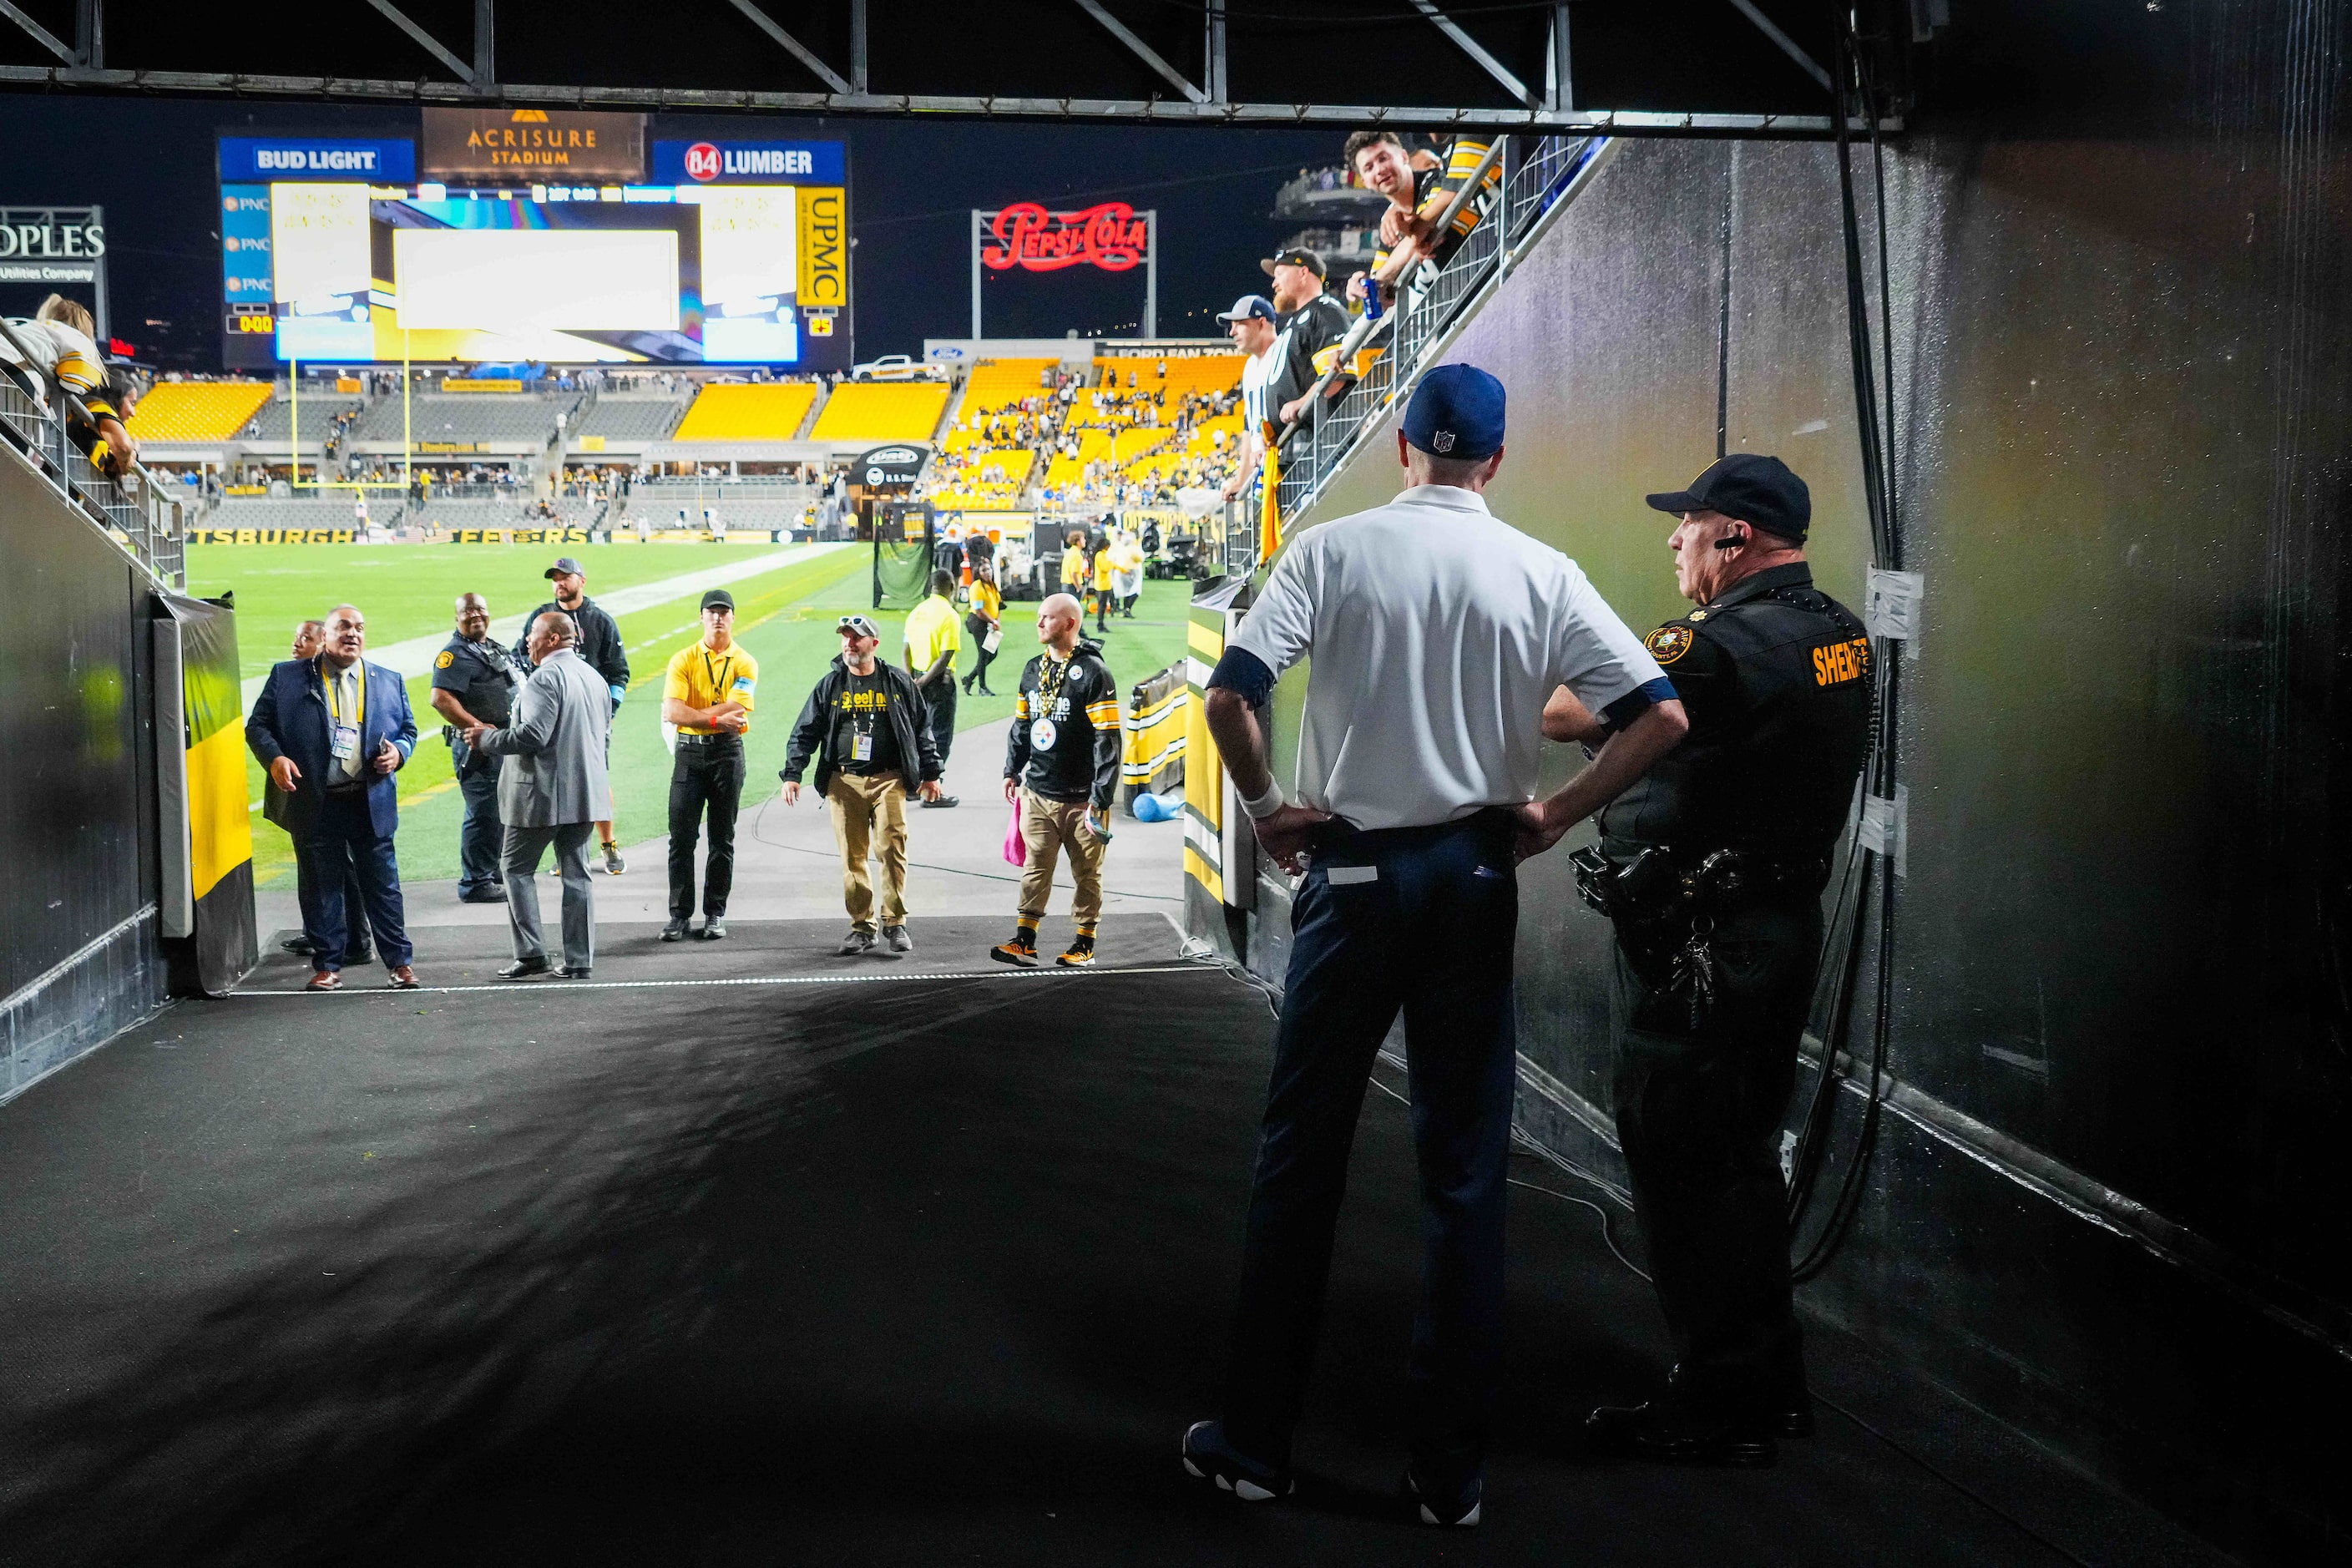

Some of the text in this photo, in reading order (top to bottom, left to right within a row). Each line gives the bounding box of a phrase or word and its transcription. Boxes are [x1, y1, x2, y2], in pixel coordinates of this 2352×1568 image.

[468, 129, 596, 148] ACRISURE
[257, 150, 376, 169] BUD LIGHT
[492, 151, 569, 165] STADIUM
[689, 150, 812, 174] 84 LUMBER
[240, 198, 270, 211] PNC
[241, 238, 271, 251] PNC
[812, 195, 839, 299] UPMC
[42, 267, 94, 282] Company
[243, 279, 272, 291] PNC
[1203, 347, 1243, 357] ZON
[184, 528, 354, 545] TSBURGH
